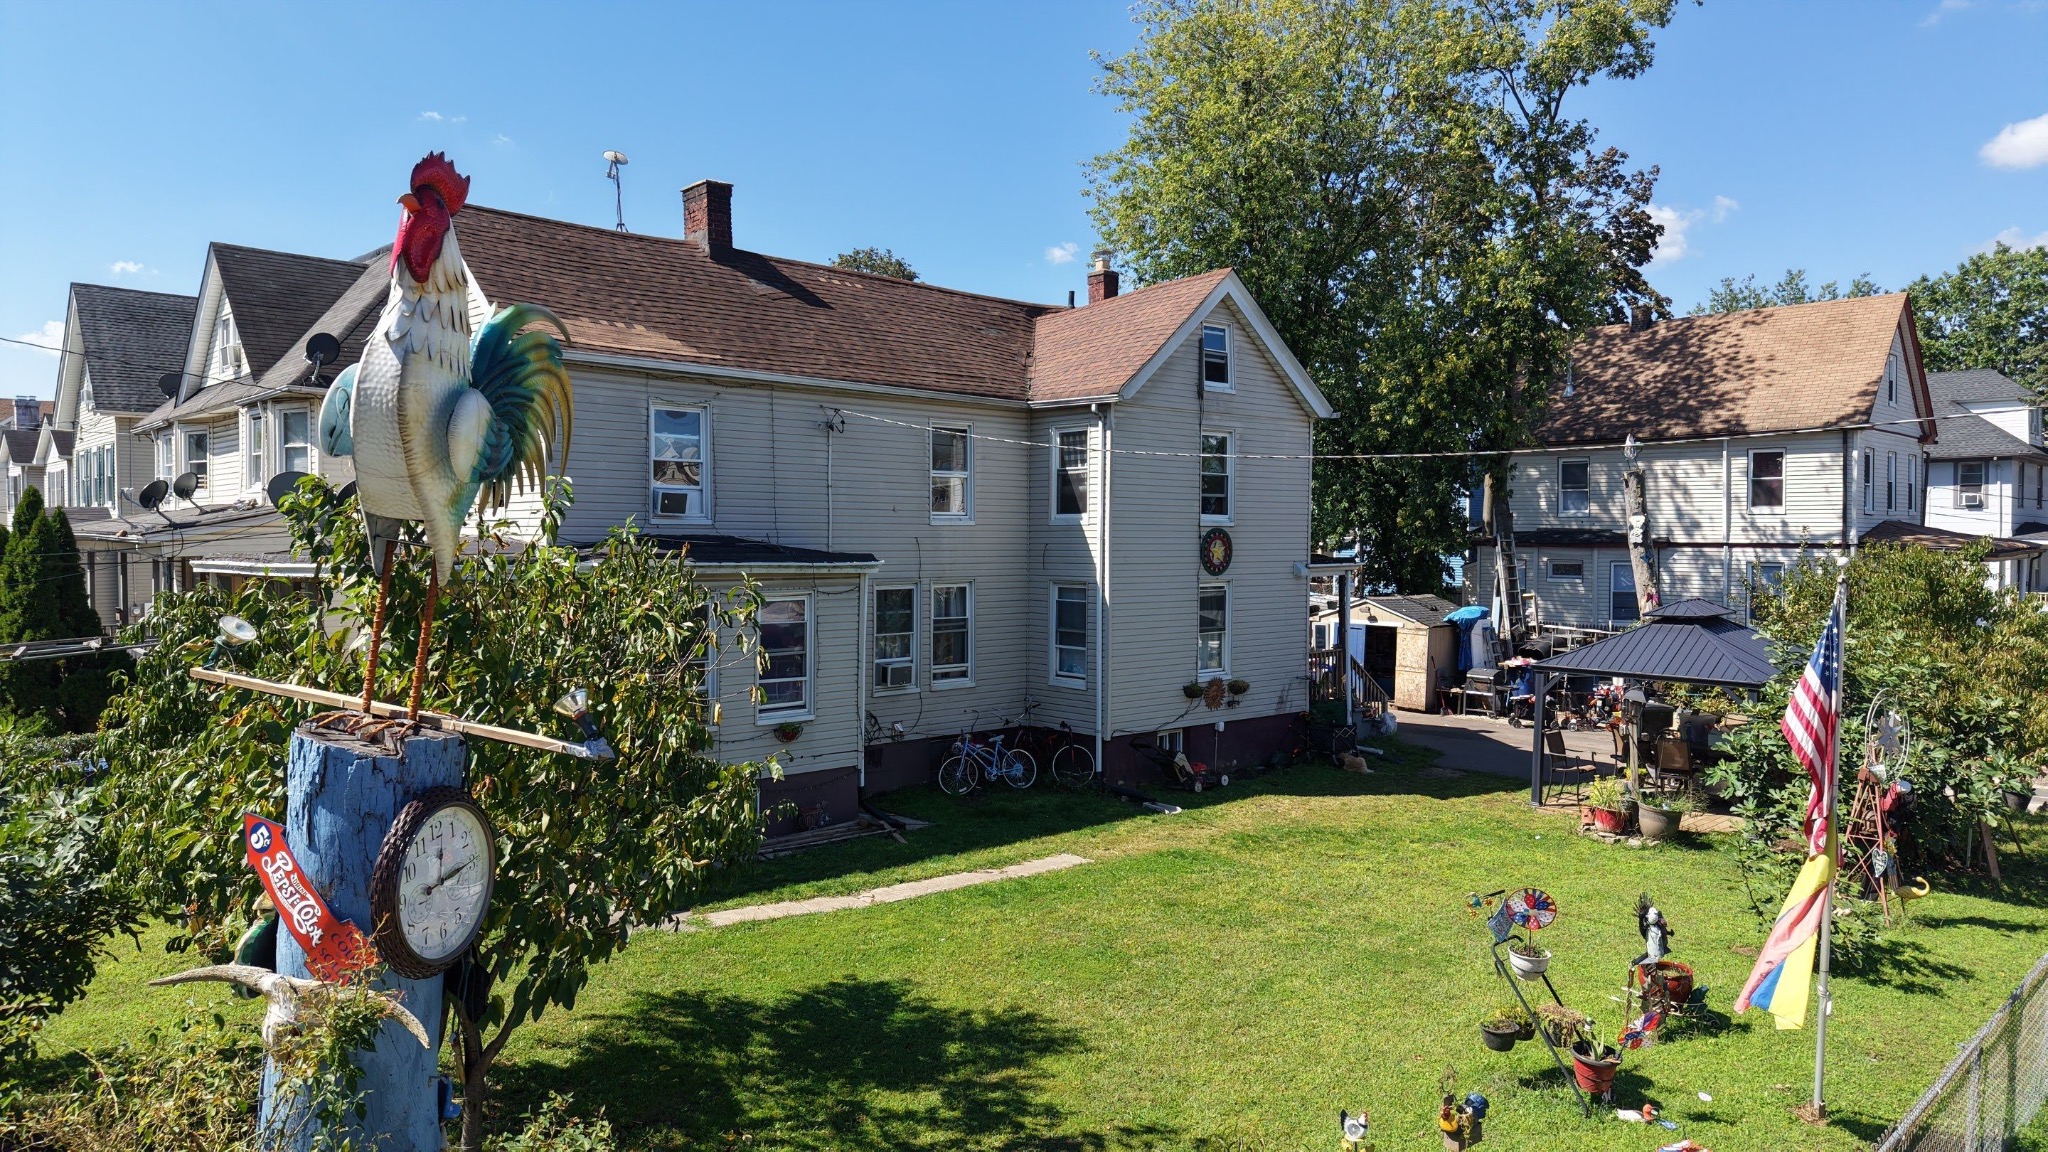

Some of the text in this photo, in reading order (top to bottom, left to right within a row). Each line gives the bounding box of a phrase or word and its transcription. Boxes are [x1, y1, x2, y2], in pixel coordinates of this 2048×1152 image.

[429, 820, 443, 842] 12
[449, 822, 455, 839] 1
[414, 837, 427, 858] 11
[461, 831, 469, 849] 2
[468, 854, 476, 871] 3
[403, 862, 416, 884] 10
[399, 894, 406, 912] 9
[455, 906, 462, 924] 5
[422, 927, 429, 945] 7
[440, 922, 447, 940] 6
